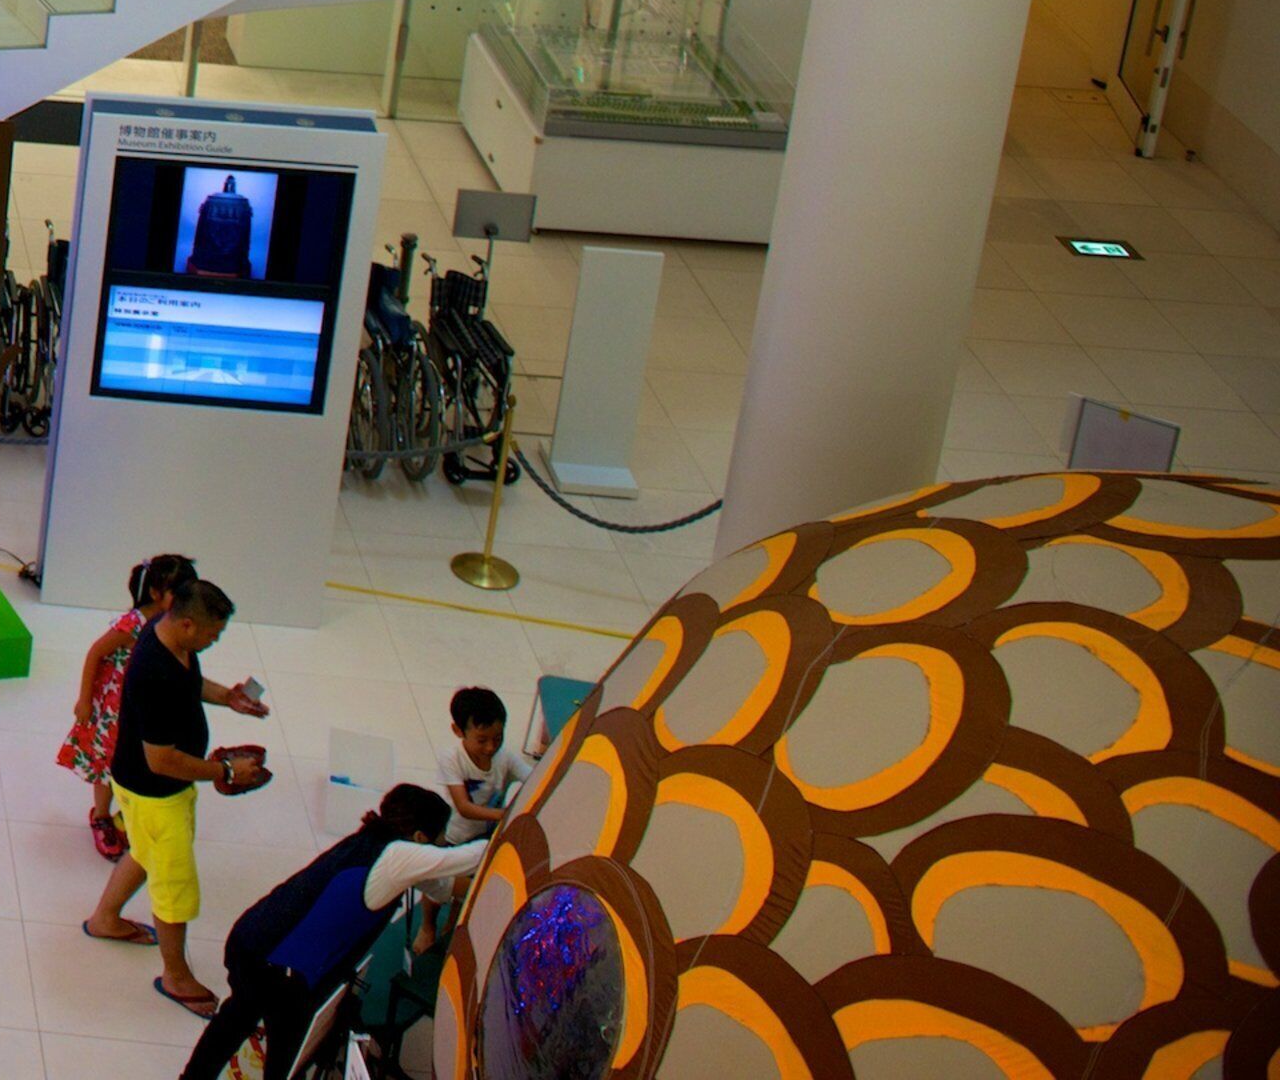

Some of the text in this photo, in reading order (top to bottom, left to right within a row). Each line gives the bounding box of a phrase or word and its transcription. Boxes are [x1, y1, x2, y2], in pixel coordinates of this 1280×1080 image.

[119, 124, 218, 144] 博物館催事案内
[117, 138, 233, 155] Museum Exhibition Guide
